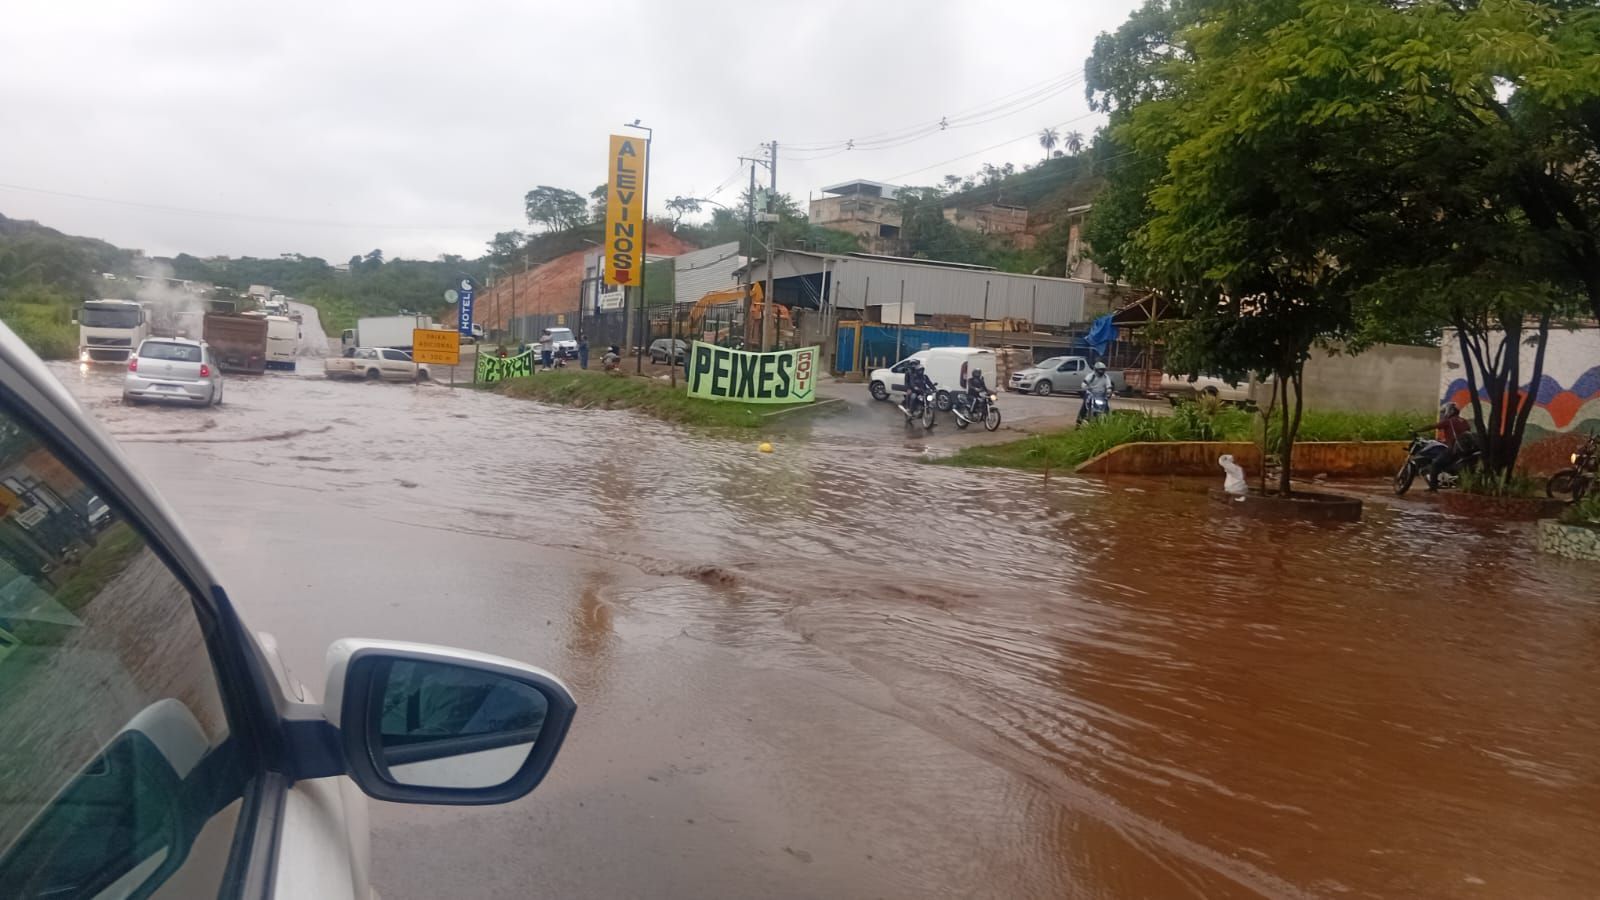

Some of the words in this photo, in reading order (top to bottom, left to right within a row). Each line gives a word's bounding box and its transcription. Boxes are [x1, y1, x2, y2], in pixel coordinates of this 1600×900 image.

[613, 140, 636, 269] ALEVINOS
[461, 293, 471, 329] HOTEL
[692, 346, 793, 398] PEIXES
